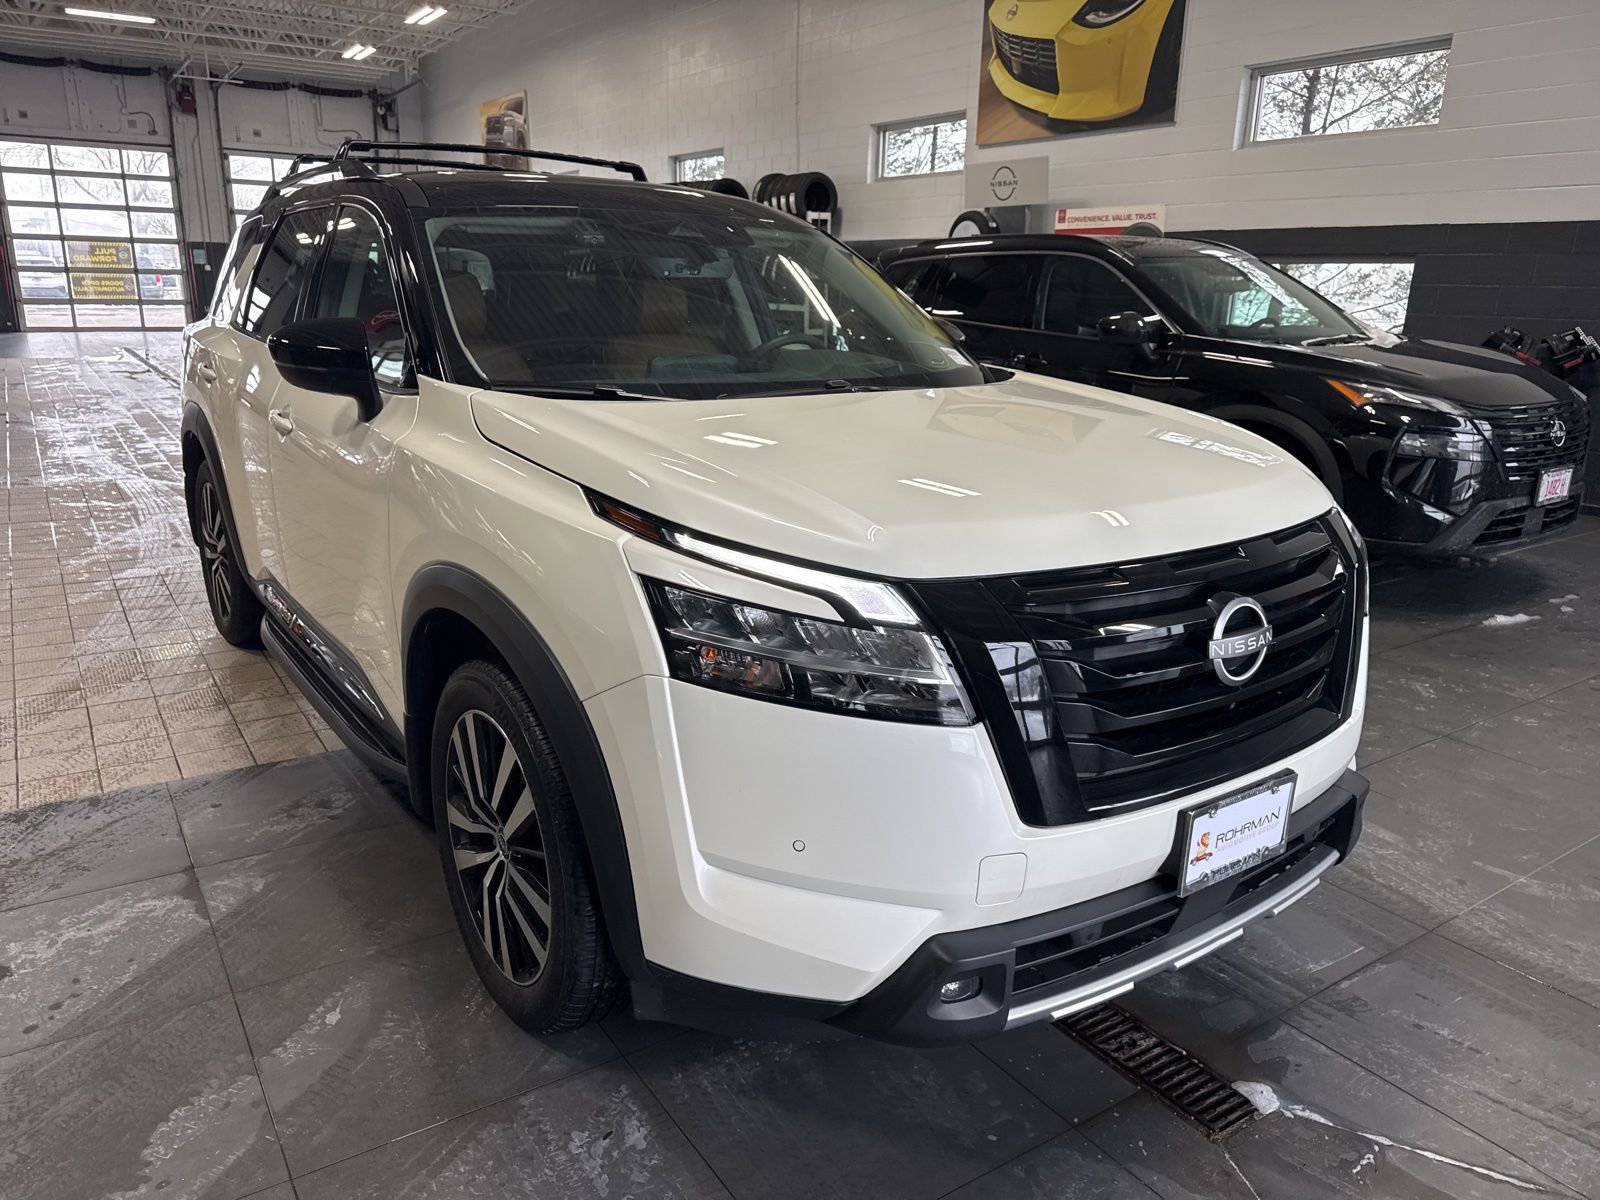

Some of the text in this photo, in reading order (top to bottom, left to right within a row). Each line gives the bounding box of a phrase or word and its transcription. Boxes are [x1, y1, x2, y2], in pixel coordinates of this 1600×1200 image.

[990, 180, 1018, 188] NISSAN
[1212, 630, 1272, 656] NISSAN
[1215, 807, 1281, 848] ROHRMAN
